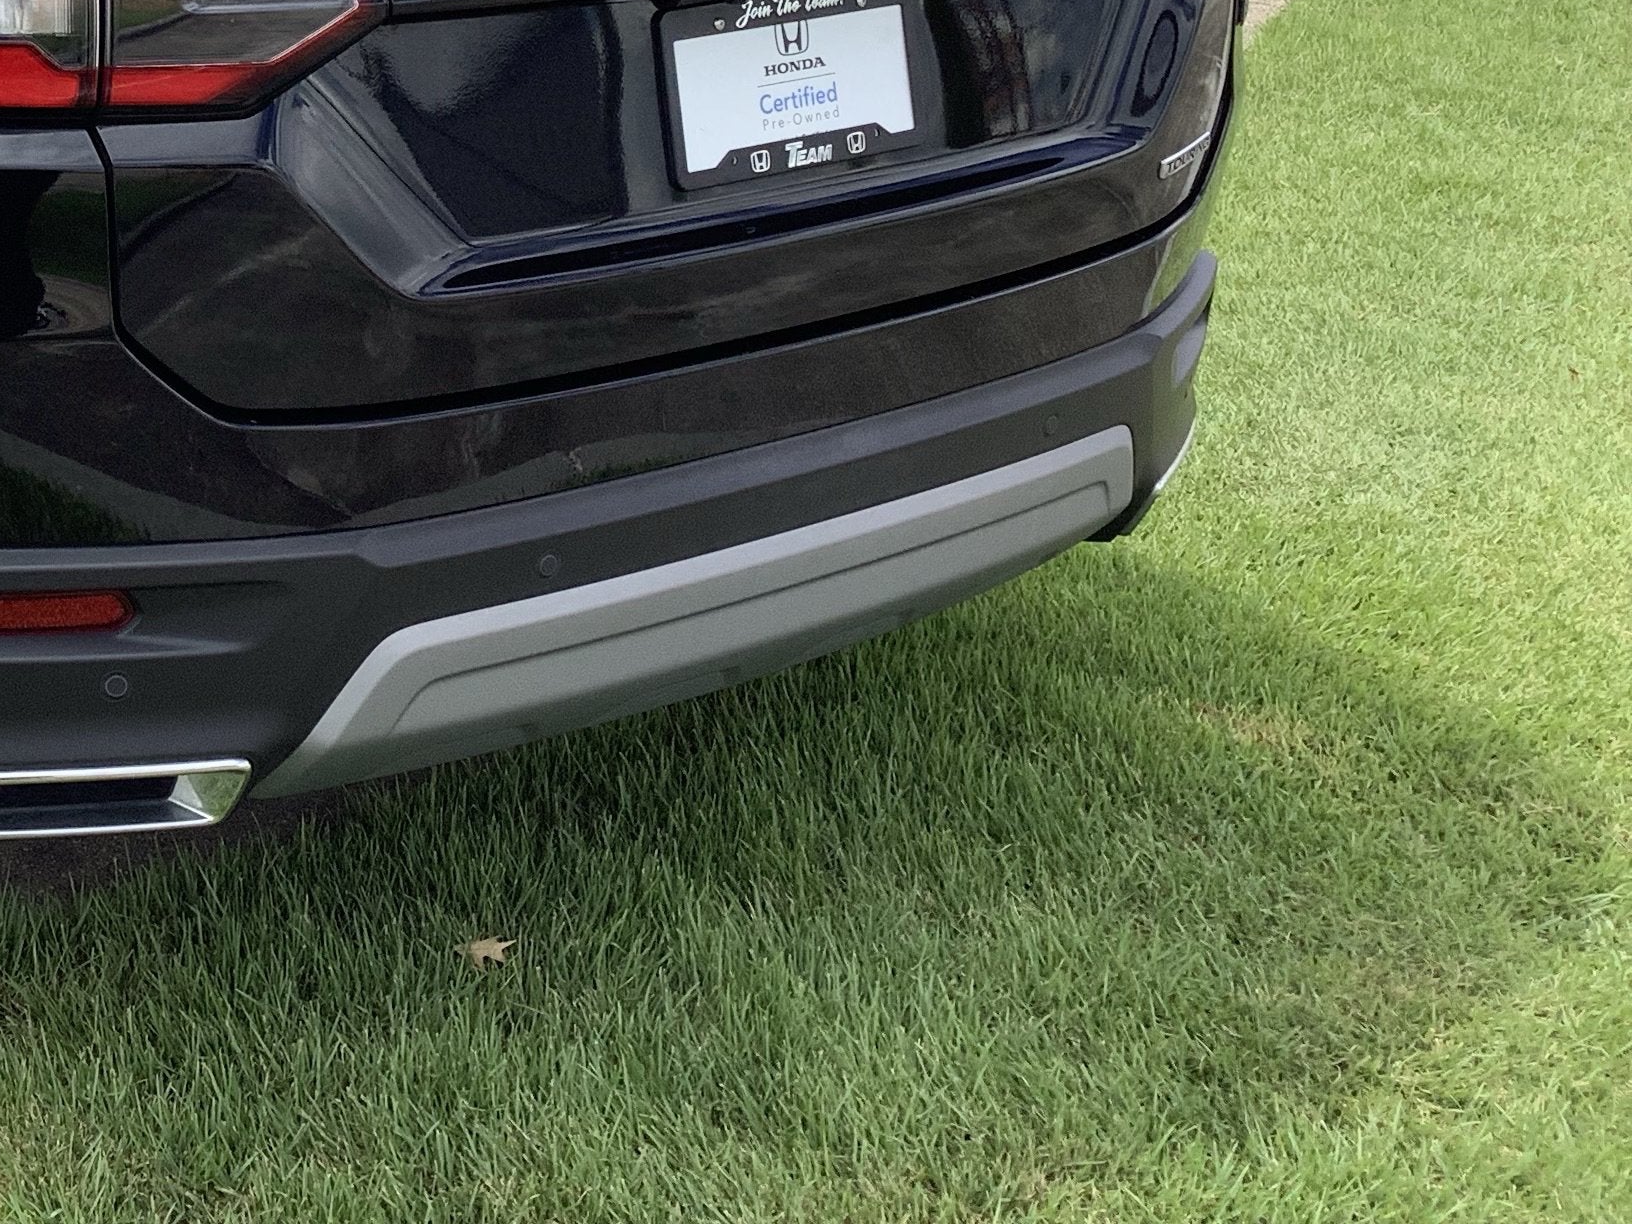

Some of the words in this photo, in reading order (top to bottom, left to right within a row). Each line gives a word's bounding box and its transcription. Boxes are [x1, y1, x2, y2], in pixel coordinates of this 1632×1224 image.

[735, 0, 773, 28] Join
[764, 56, 826, 76] HONDA
[759, 81, 838, 114] Certified
[762, 106, 840, 131] Pre-Owned
[784, 141, 833, 168] TEAM
